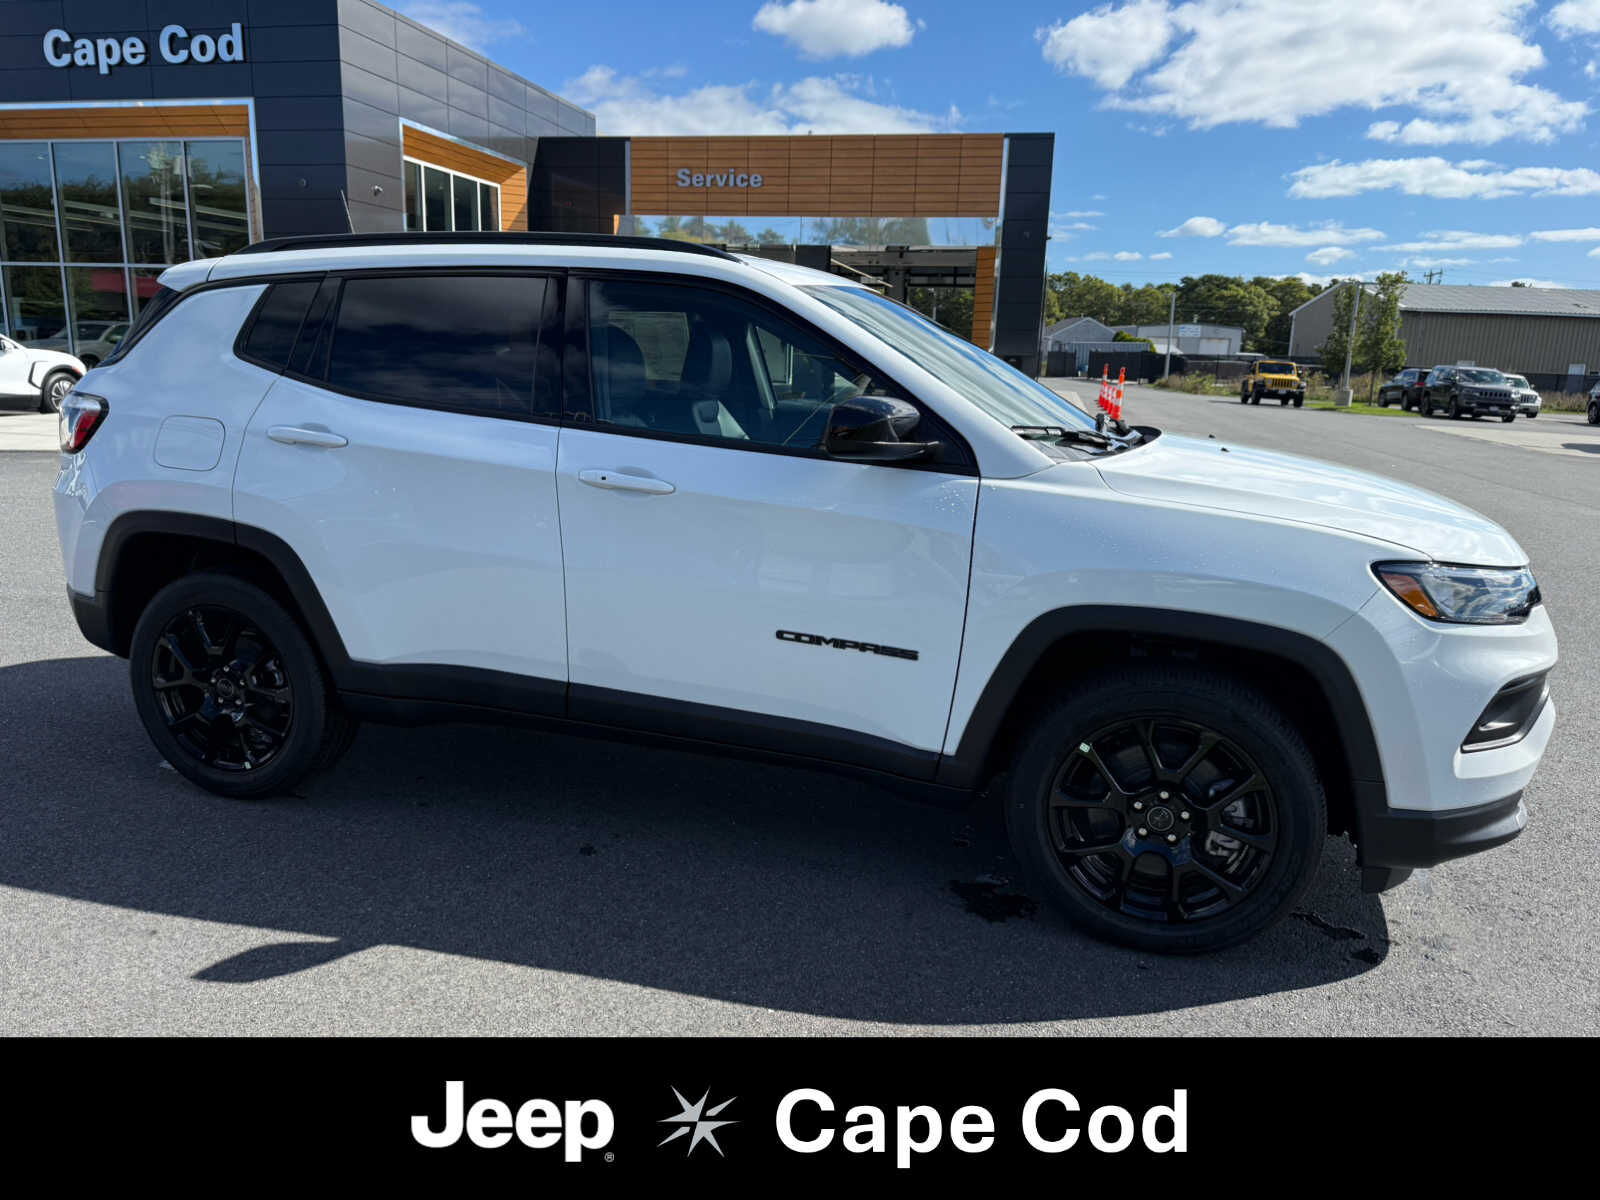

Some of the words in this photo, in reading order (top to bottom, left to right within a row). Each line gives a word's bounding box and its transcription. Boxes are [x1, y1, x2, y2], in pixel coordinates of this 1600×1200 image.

[43, 28, 147, 75] Cape
[159, 22, 244, 64] Cod
[676, 167, 763, 189] Service
[775, 629, 919, 661] COMPASS
